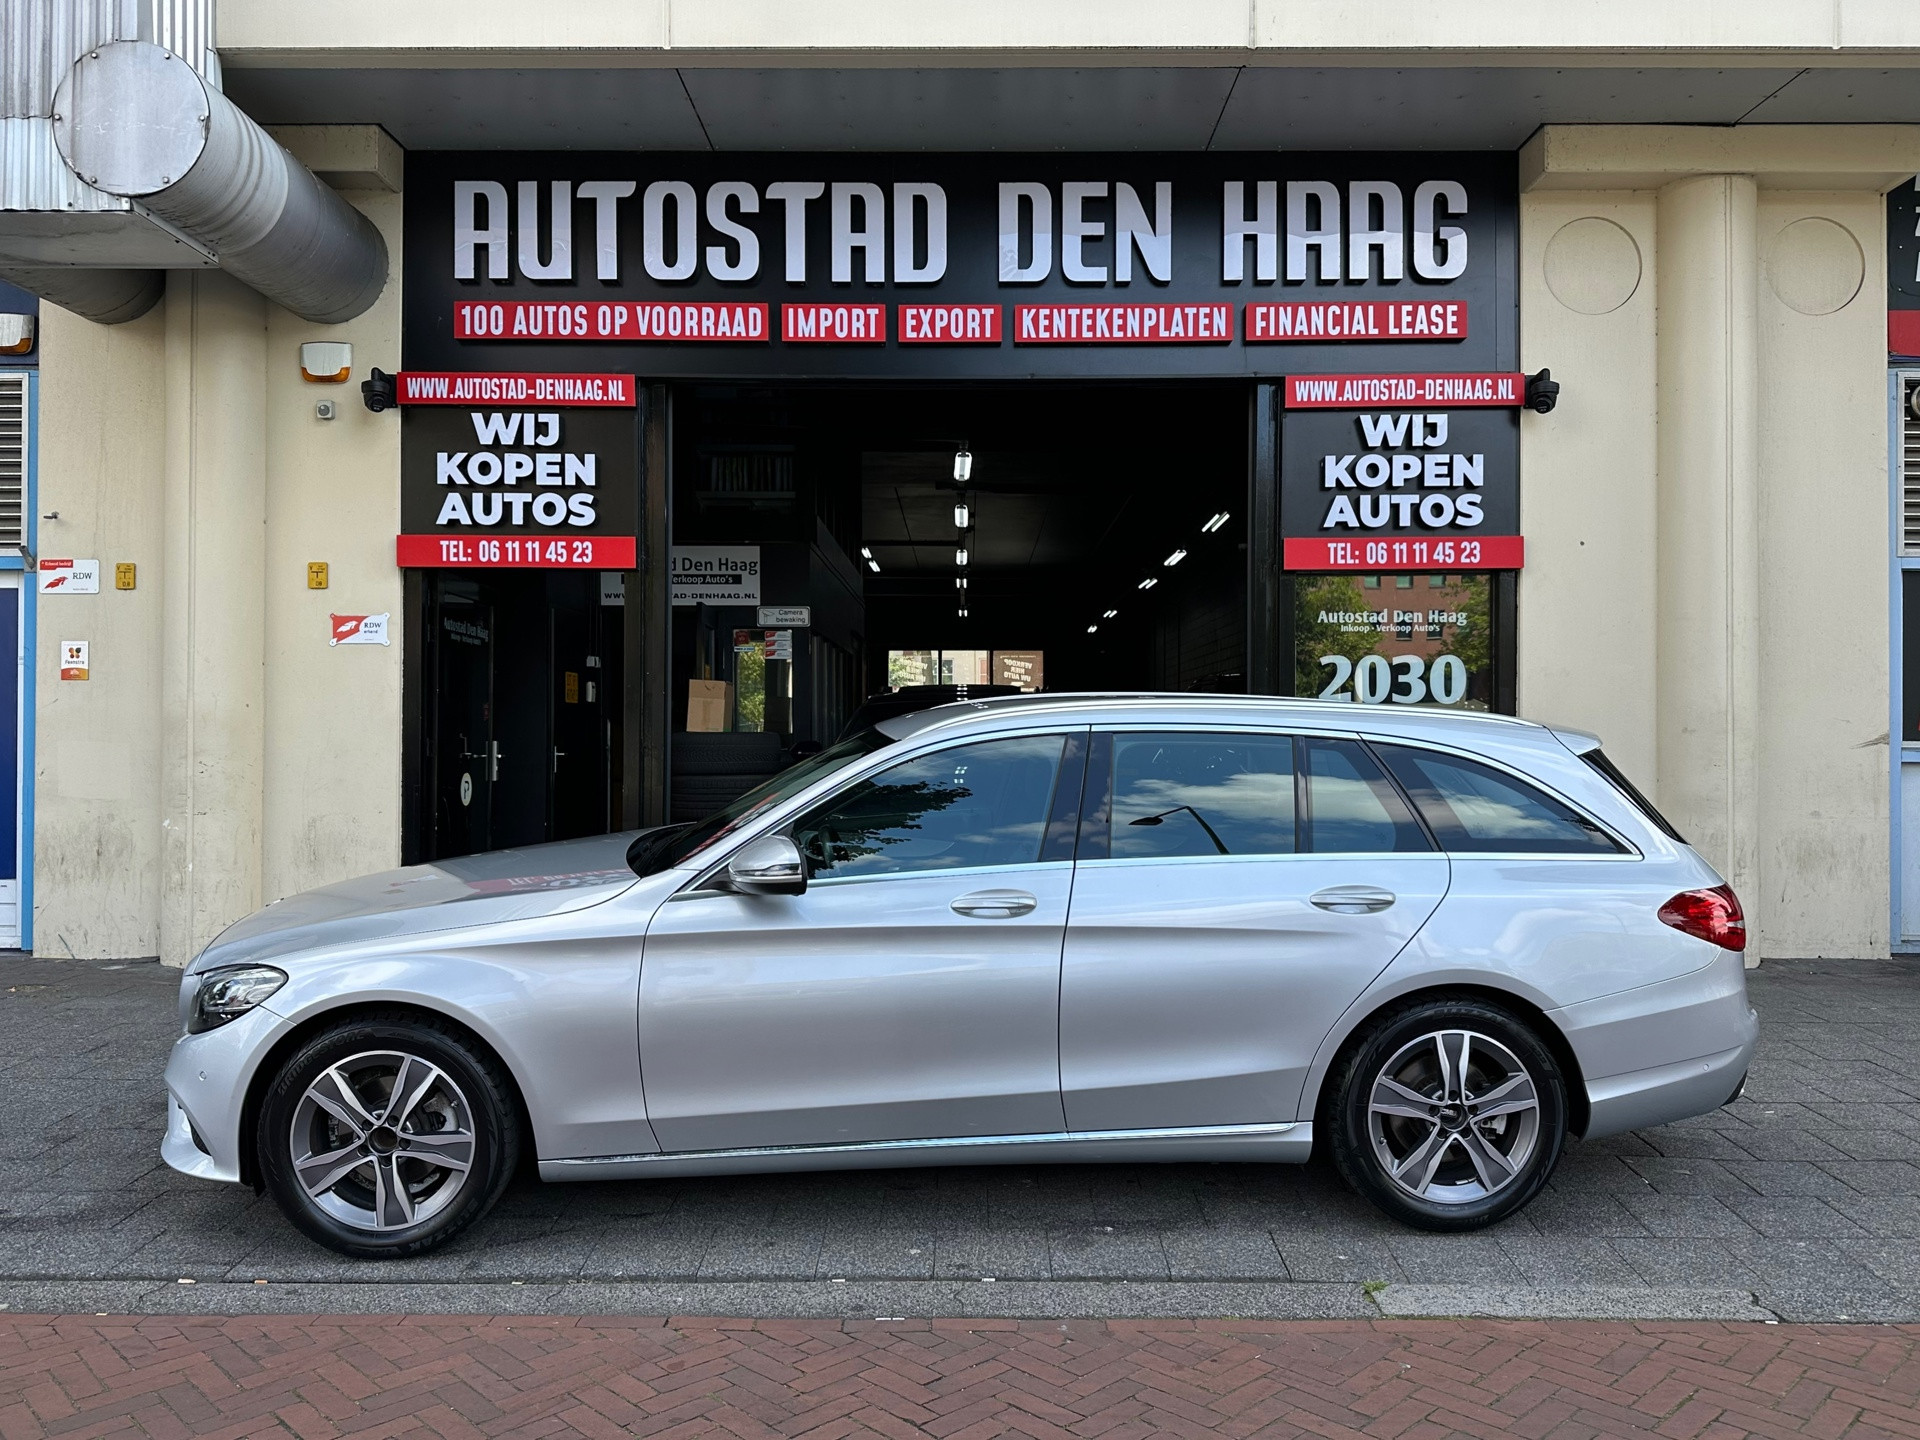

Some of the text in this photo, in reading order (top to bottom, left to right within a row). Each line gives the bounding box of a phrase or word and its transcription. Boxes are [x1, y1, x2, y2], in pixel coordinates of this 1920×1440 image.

[454, 180, 1468, 282] AUTOSTAD DEN HAAG
[461, 304, 762, 337] 100 AUTOS OP VOORRAAD
[788, 307, 879, 338] IMPORT
[906, 307, 994, 338] EXPORT
[1022, 306, 1226, 338] KENTEKENPLATEN
[1255, 304, 1458, 336] FINANCIAL LEASE
[406, 377, 626, 401] WWW.AUTOSTAD-DENHAAG.NL
[1295, 378, 1516, 402] WWW.AUTOSTAD-DENHAAG.NL
[470, 412, 560, 446] WIJ
[1359, 413, 1448, 447] WIJ
[436, 452, 596, 486] KOPEN
[1324, 453, 1484, 488] KOPEN
[435, 492, 596, 527] AUTOS
[1323, 493, 1485, 528] AUTOS
[440, 540, 593, 563] TEL: 06 11 11 45 23
[682, 558, 713, 572] Den
[718, 558, 758, 575] Haag
[1327, 541, 1481, 564] TEL: 06 11 11 45 23
[72, 572, 92, 580] RDW
[672, 575, 733, 584] erkoop Auto's
[776, 616, 806, 624] bewaking
[1317, 608, 1468, 625] Autostad Den Haag
[1341, 624, 1440, 633] Inkoop Verkoop Auto's
[1319, 654, 1467, 705] 2030
